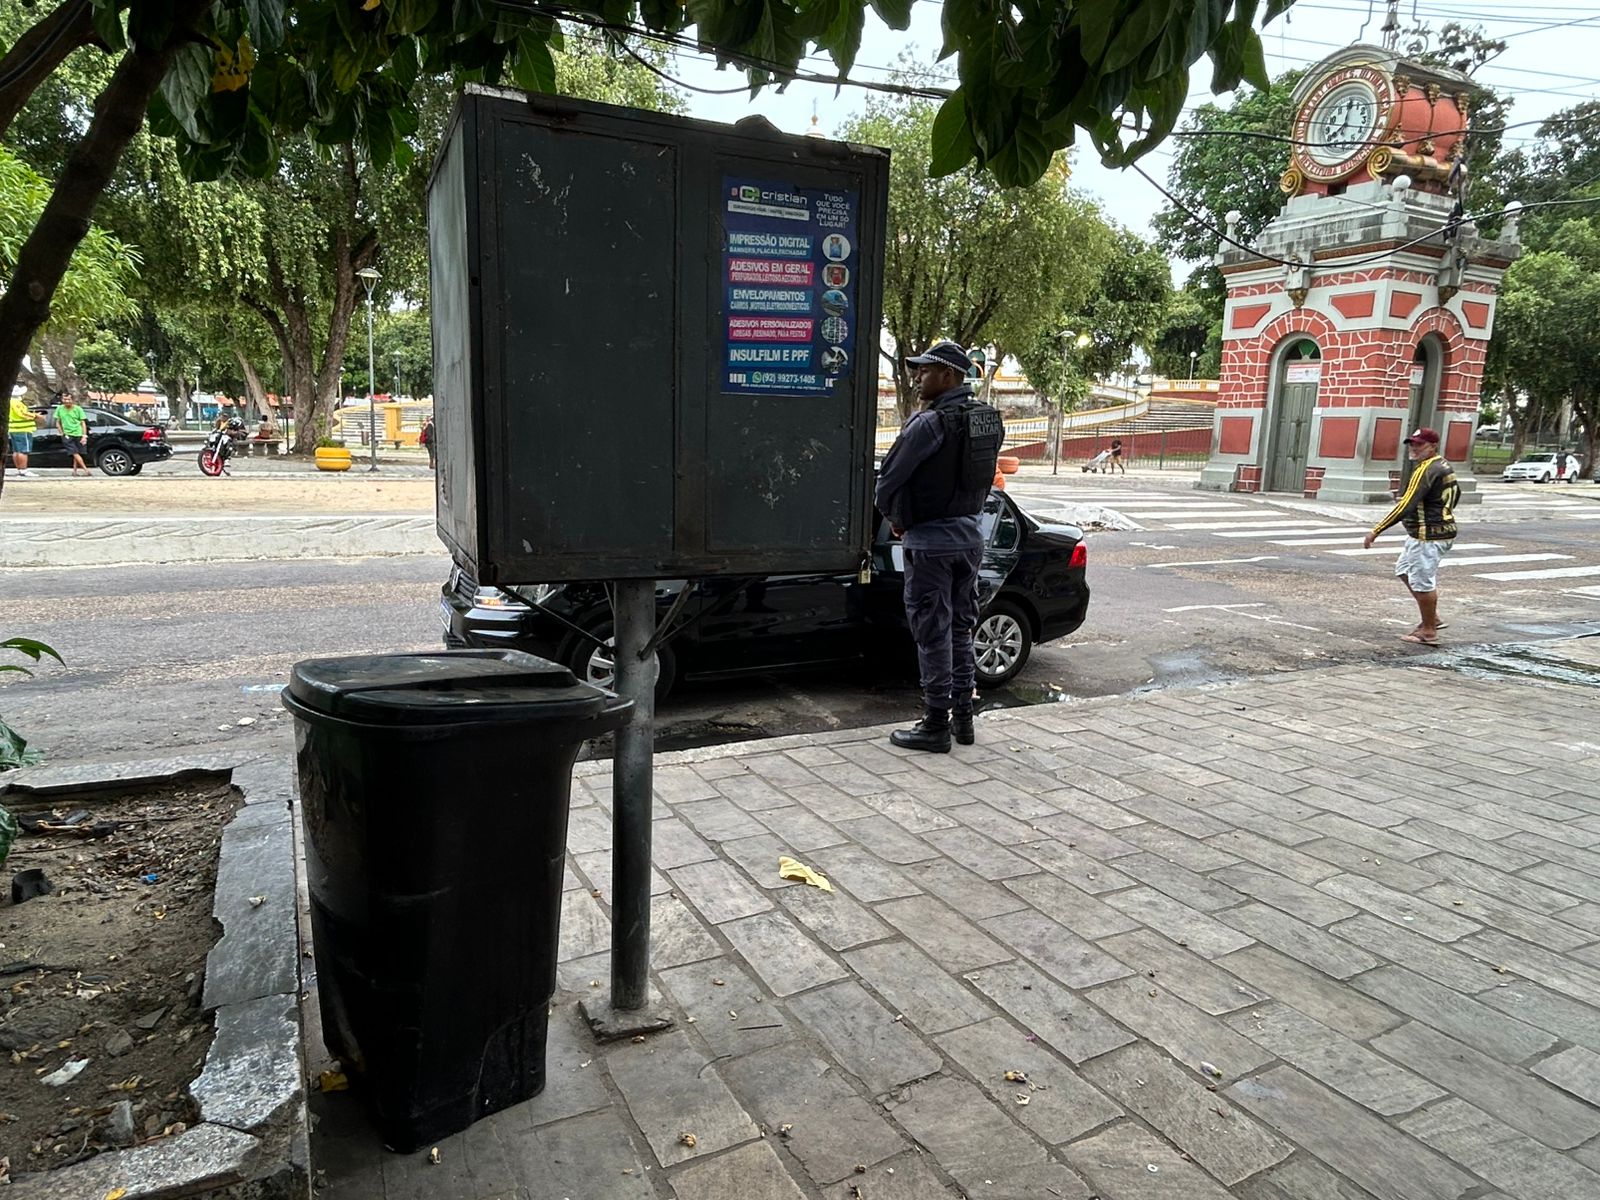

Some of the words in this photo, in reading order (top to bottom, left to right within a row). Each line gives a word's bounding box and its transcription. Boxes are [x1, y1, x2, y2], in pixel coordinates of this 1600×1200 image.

[761, 191, 808, 205] cristian
[815, 200, 831, 208] QUE
[824, 193, 843, 203] TUDO
[818, 207, 847, 216] PRECISA
[729, 233, 777, 247] IMPRESSÃO
[778, 236, 810, 248] DIGITAL
[730, 260, 770, 272] ADESIVOS
[771, 263, 783, 273] EM
[784, 263, 811, 274] GERAL
[733, 289, 806, 302] ENVELOPAMENTOS
[729, 319, 759, 328] ADESIVOS
[760, 320, 812, 329] PERSONALIZADOS
[730, 349, 781, 362] INSULFILM
[782, 349, 789, 362] E
[791, 349, 810, 362] PPF
[762, 372, 776, 384] (92)
[777, 374, 816, 384] 99273-1405
[970, 424, 999, 435] MILITAR
